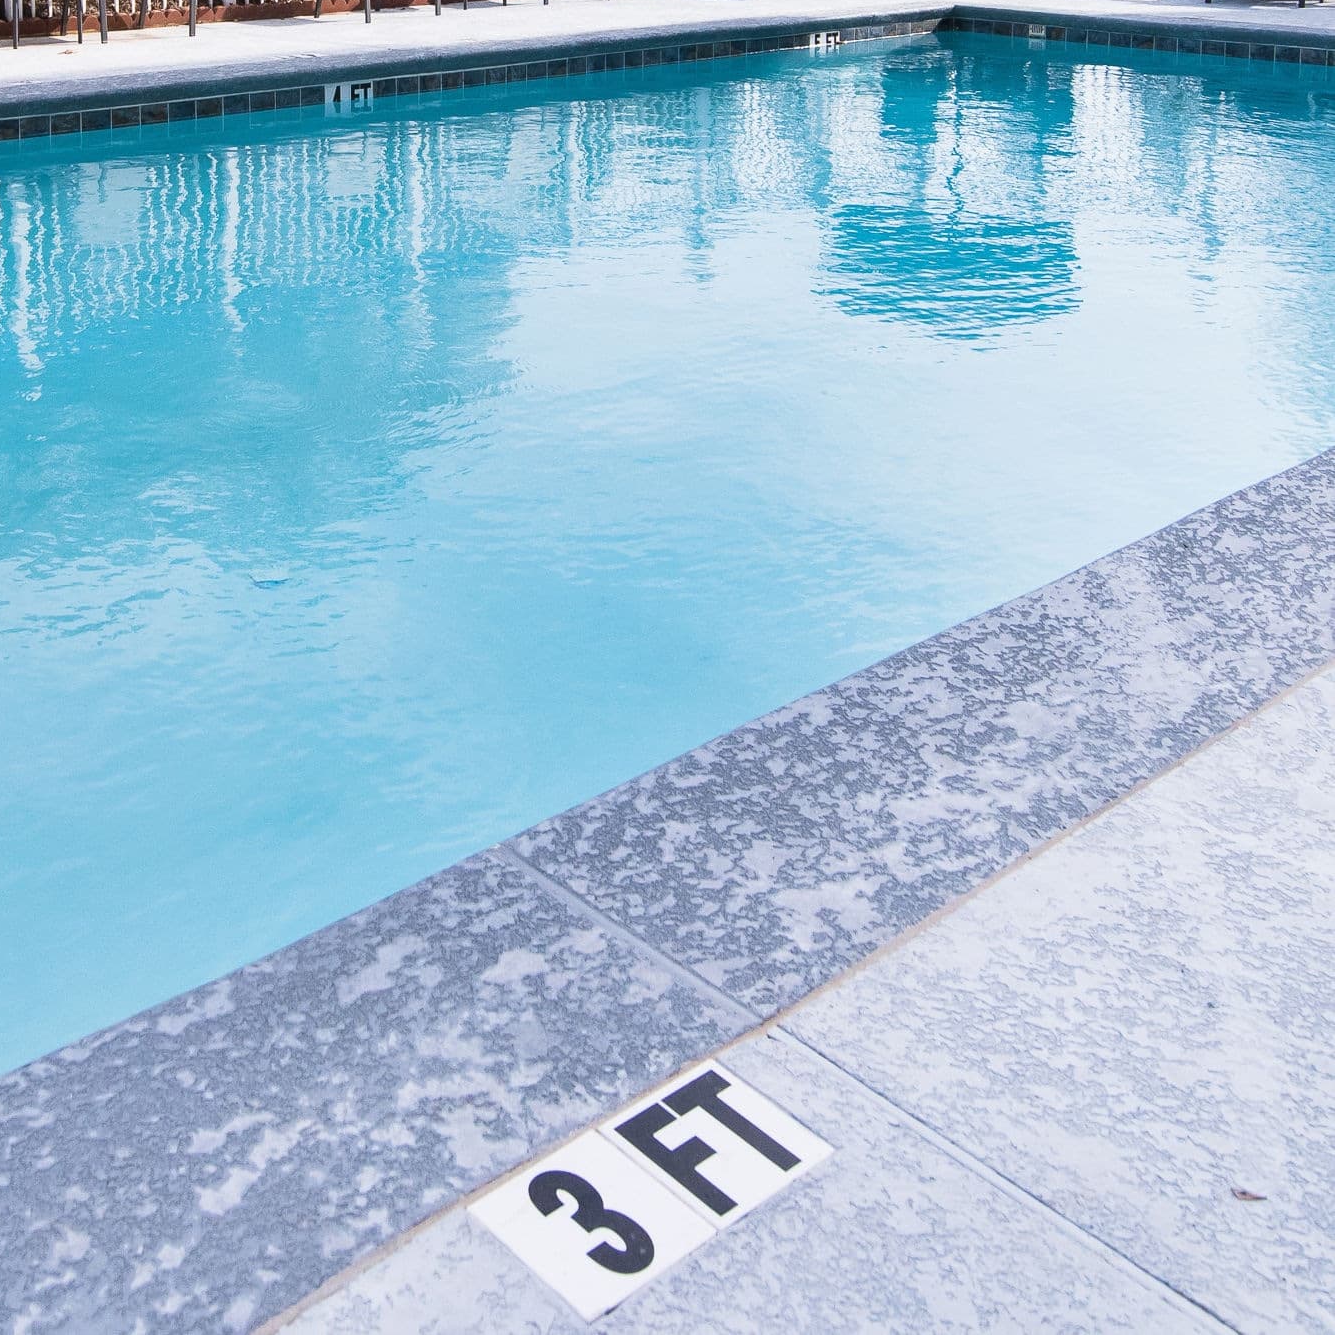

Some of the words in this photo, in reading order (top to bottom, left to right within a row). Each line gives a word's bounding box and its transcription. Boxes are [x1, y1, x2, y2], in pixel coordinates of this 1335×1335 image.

[350, 82, 371, 101] FT
[528, 1170, 655, 1274] 3
[614, 1069, 802, 1217] FT
